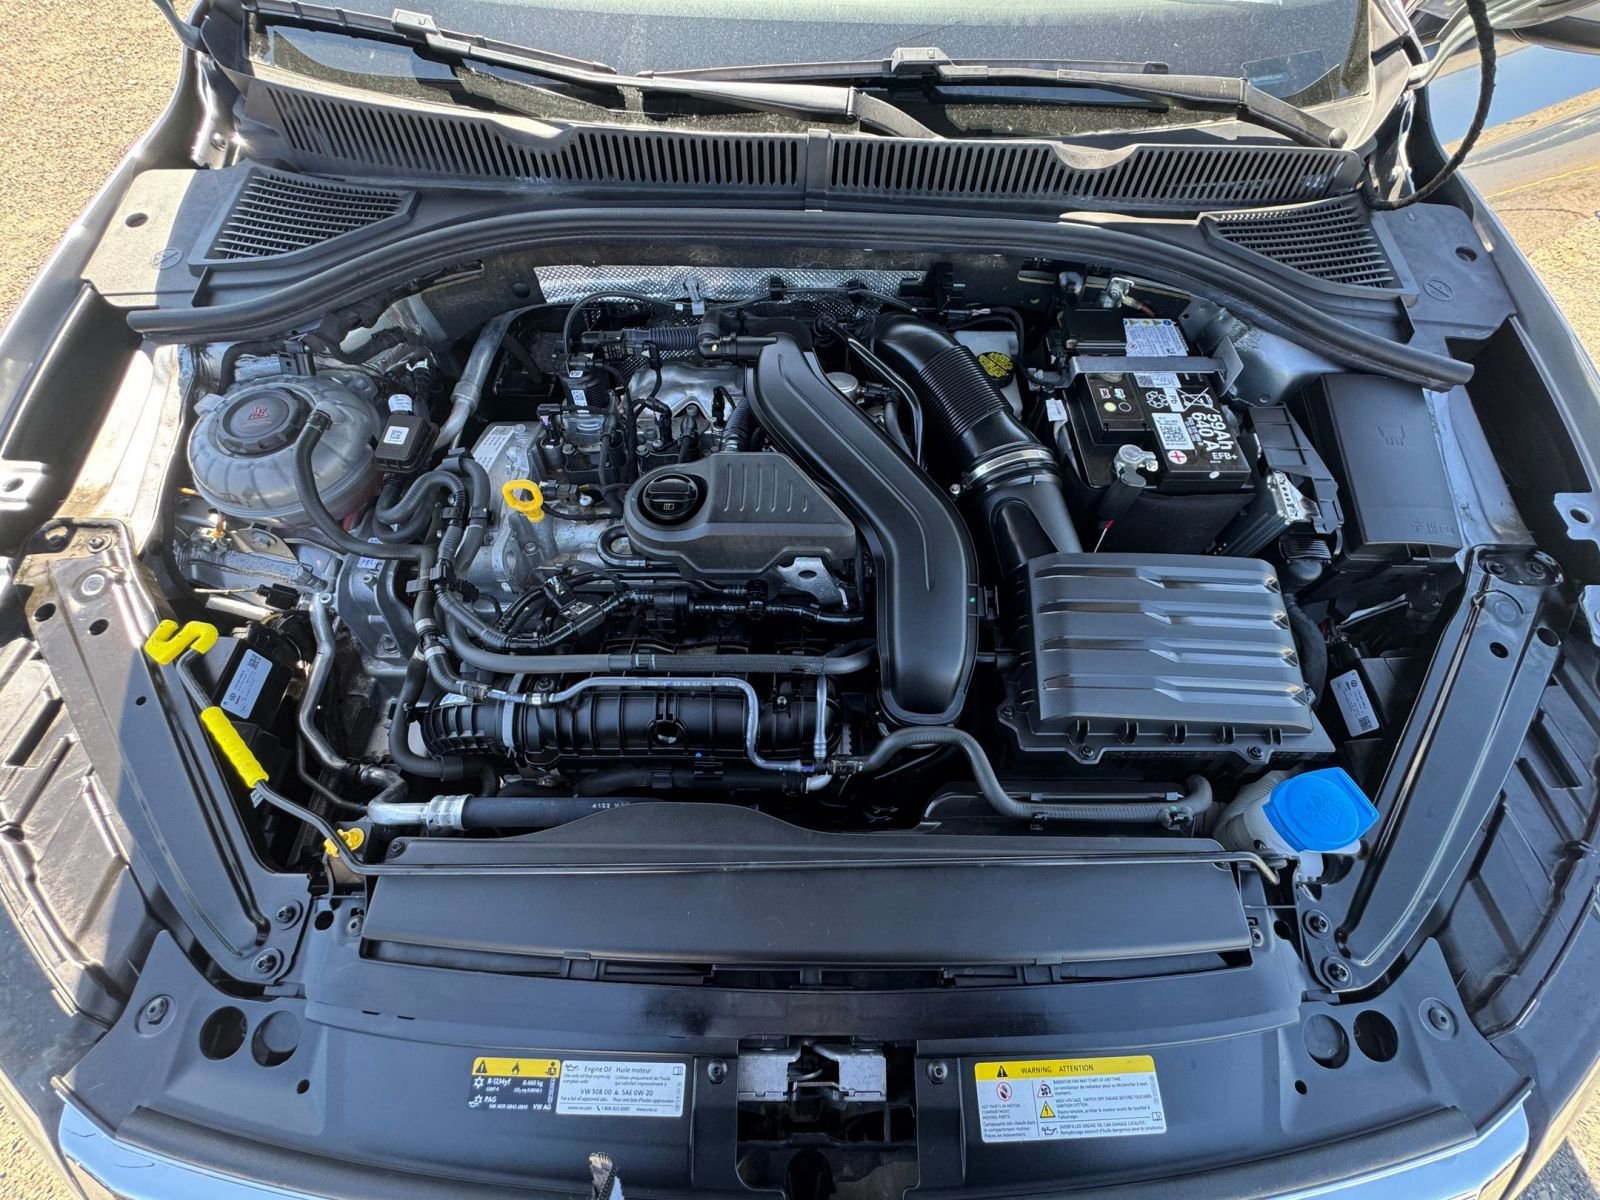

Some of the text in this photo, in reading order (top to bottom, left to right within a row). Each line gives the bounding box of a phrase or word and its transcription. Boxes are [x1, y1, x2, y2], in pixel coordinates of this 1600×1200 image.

[1169, 395, 1178, 404] Pb
[1191, 412, 1214, 438] 640
[1203, 440, 1220, 452] A
[1206, 414, 1234, 450] 59Ah
[1020, 1064, 1094, 1074] WARNING ATTENTION
